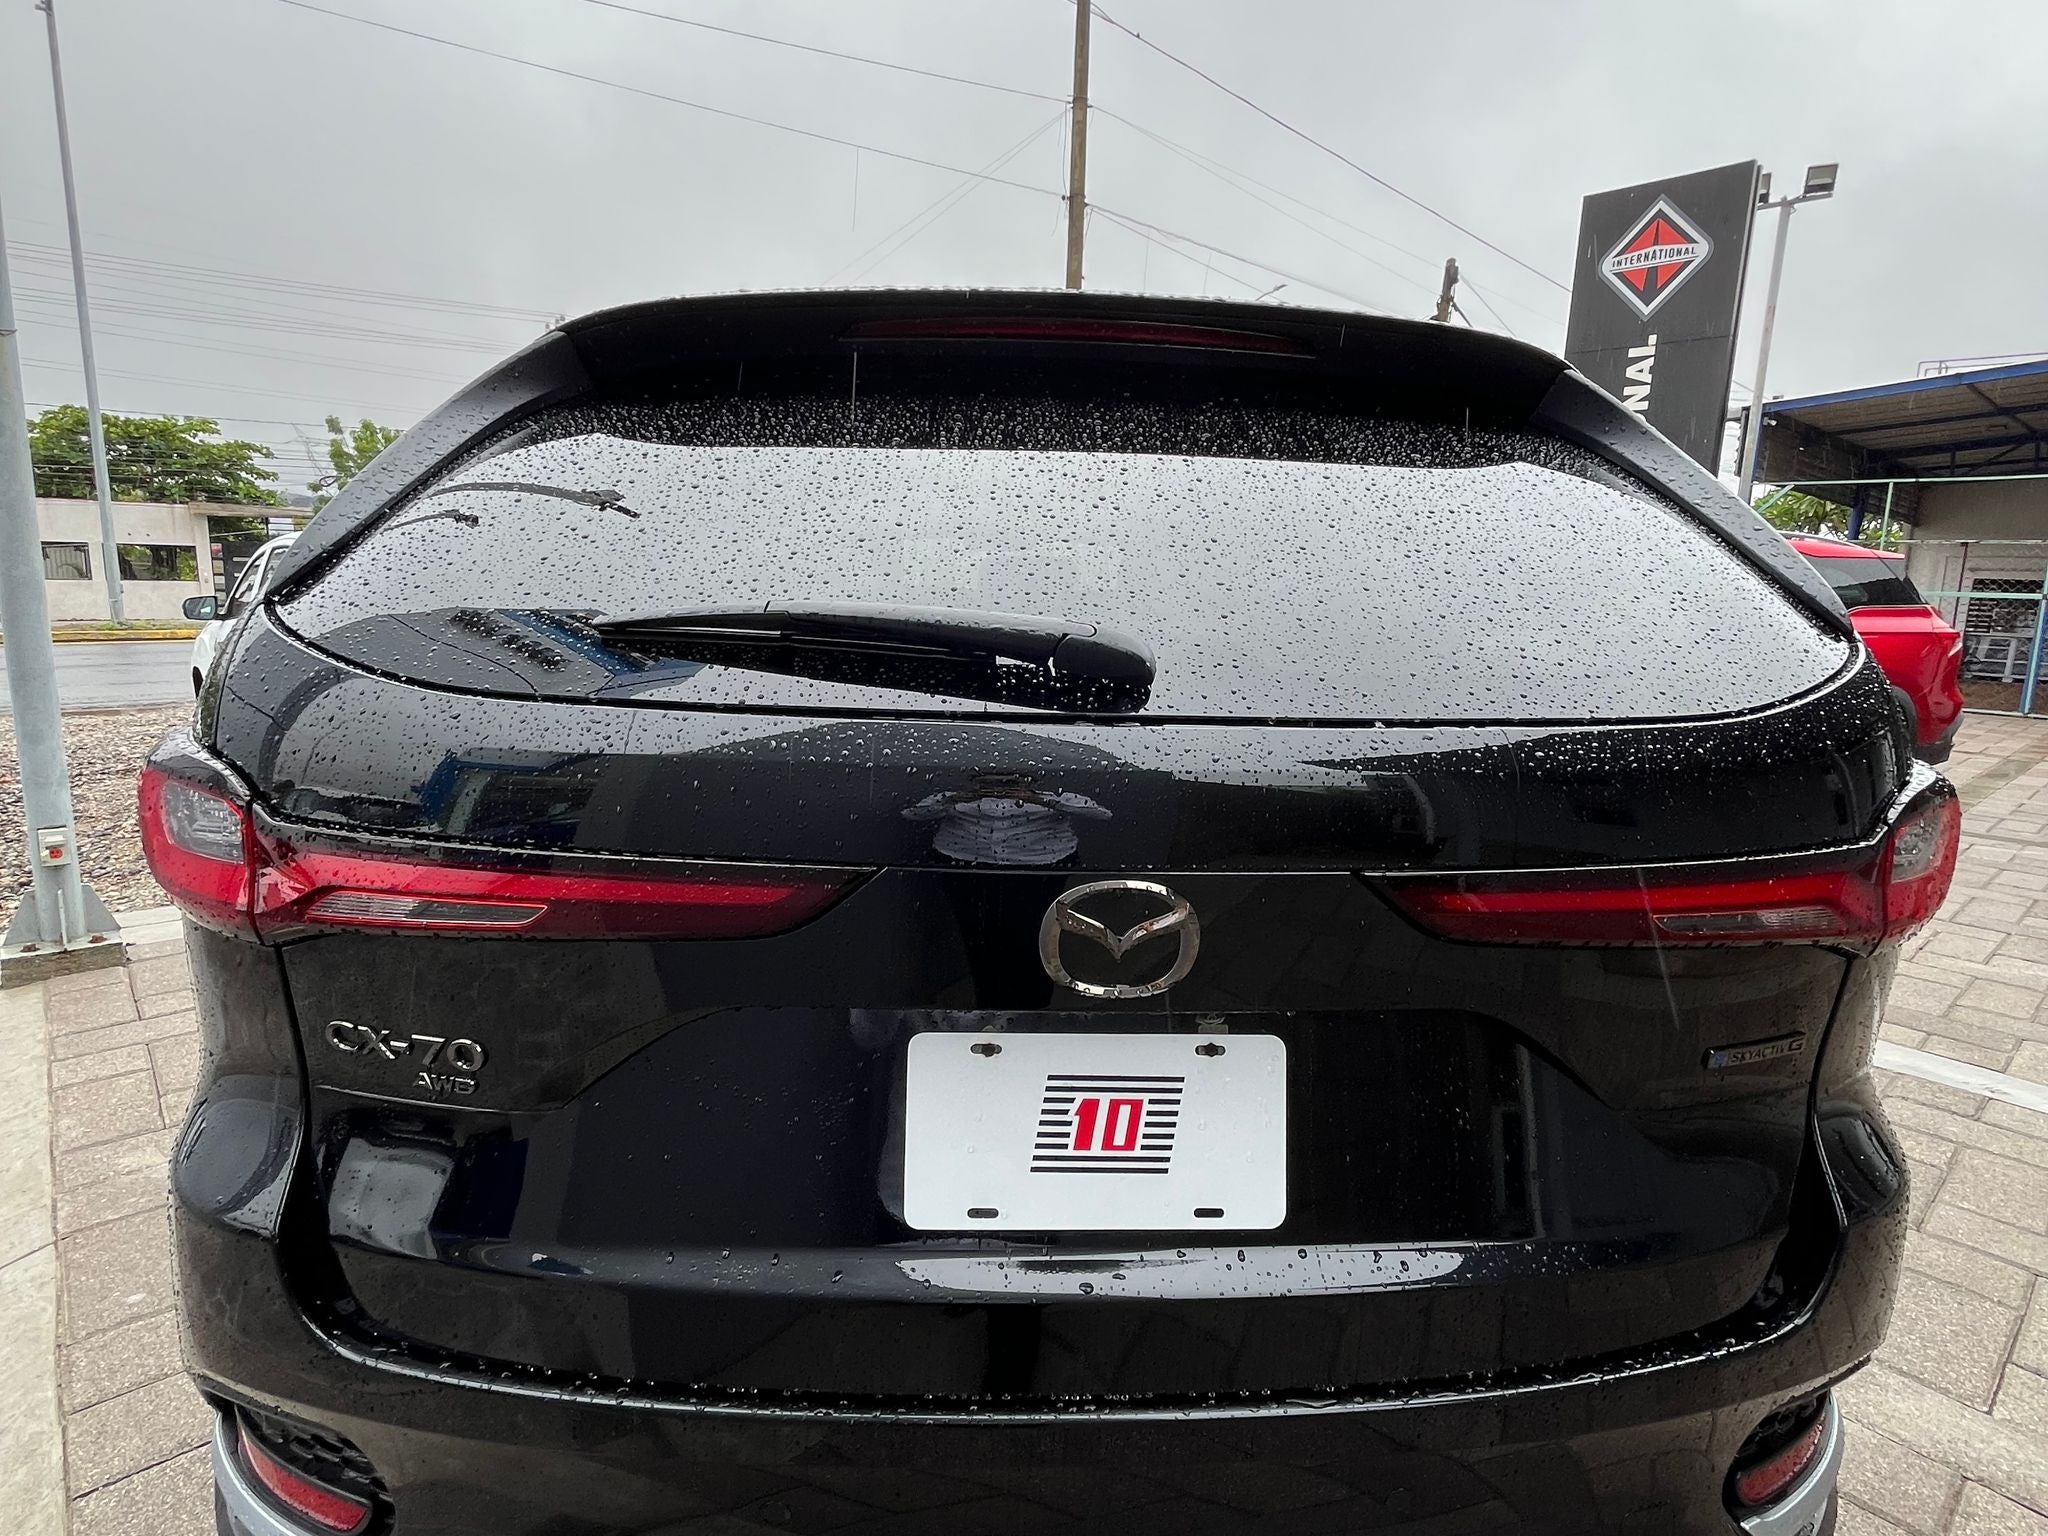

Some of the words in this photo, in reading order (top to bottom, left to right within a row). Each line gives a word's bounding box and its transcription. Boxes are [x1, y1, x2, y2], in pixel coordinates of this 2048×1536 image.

[1612, 246, 1696, 268] INTERNATIONAL
[1622, 334, 1657, 421] NAL
[325, 1020, 488, 1072] CX-70
[413, 1071, 480, 1095] AWD
[1072, 1098, 1144, 1151] 10
